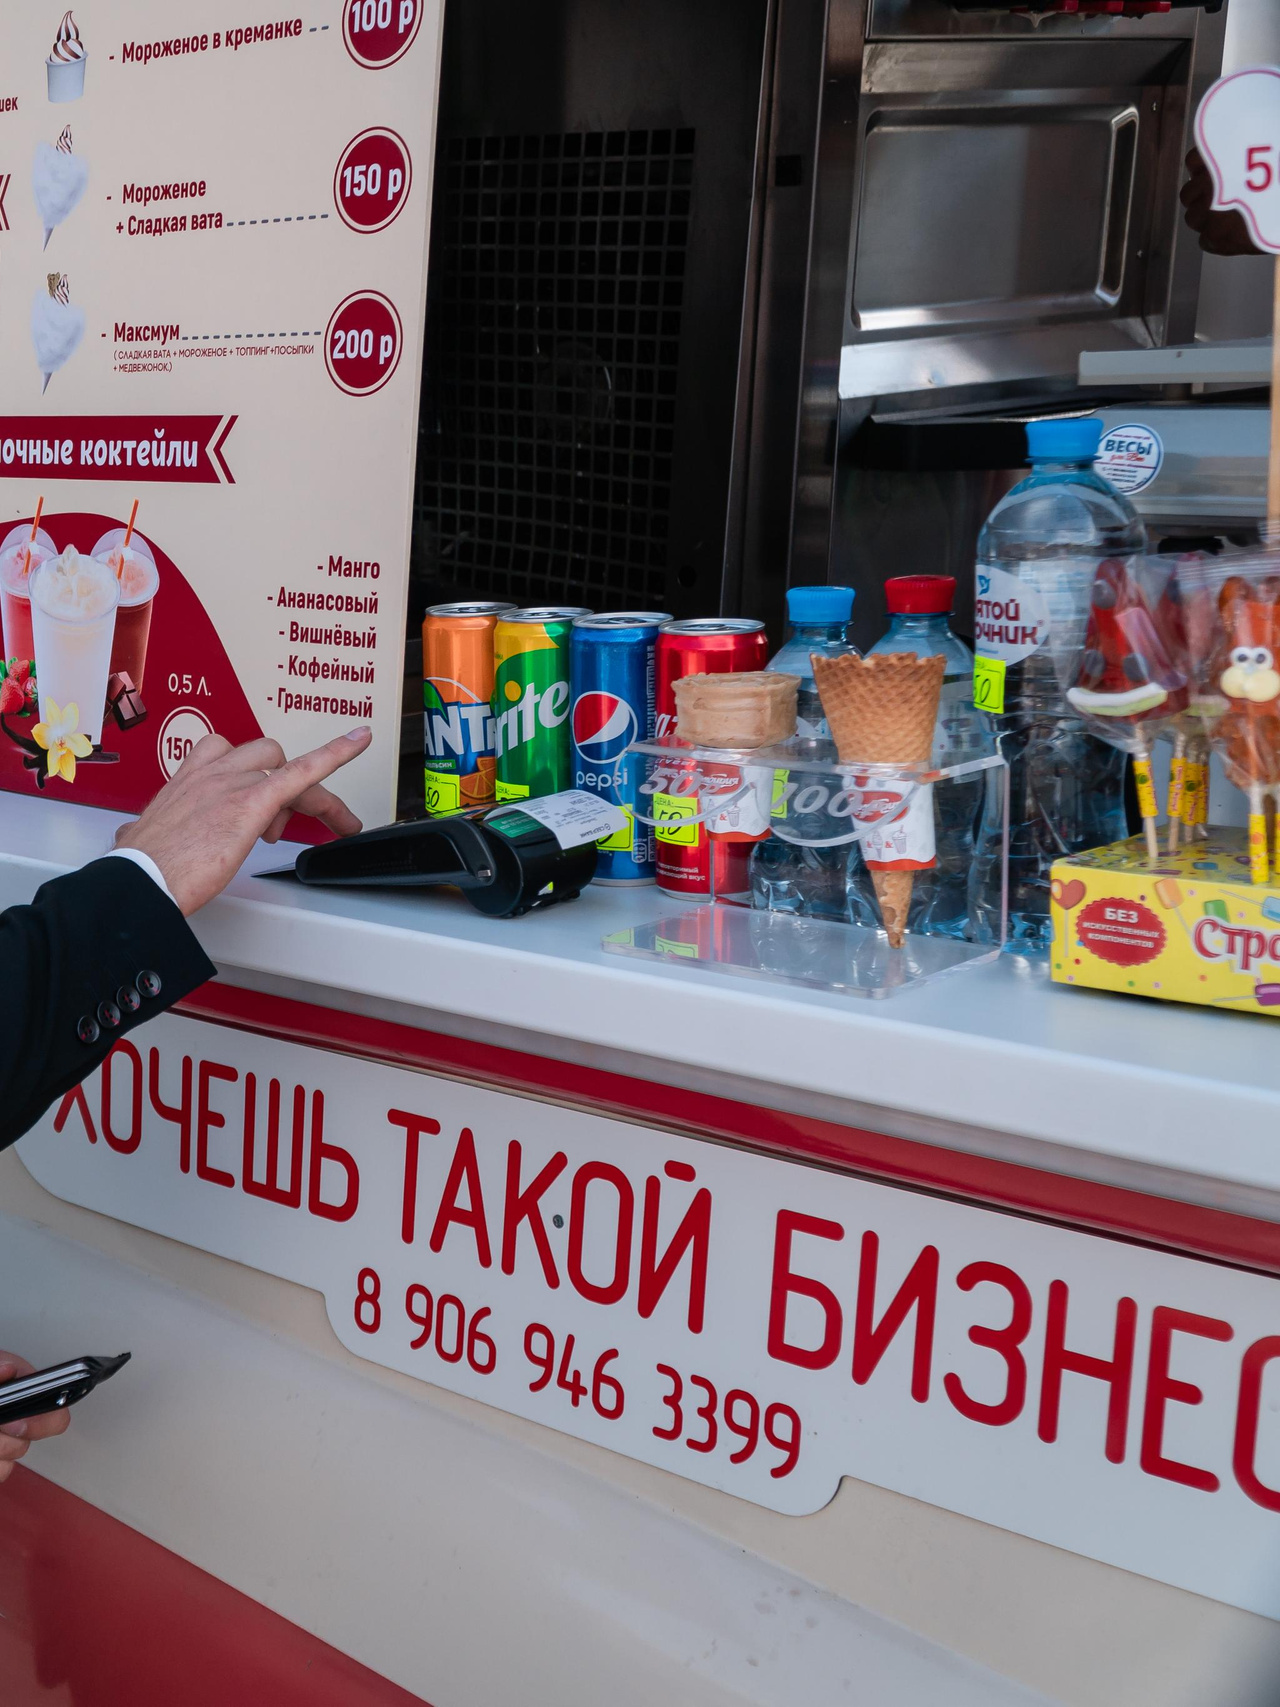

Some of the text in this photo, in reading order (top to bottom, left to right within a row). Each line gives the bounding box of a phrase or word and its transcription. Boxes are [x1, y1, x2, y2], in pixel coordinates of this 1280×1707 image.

[121, 18, 303, 65] Мороженое в креманке
[343, 163, 382, 196] 150
[1245, 145, 1280, 192] 5
[122, 179, 207, 204] Мороженое
[127, 212, 187, 238] Сладкая
[191, 209, 223, 232] вата
[114, 322, 180, 345] Максмум
[332, 329, 372, 359] 200
[154, 350, 171, 359] ВАТА
[179, 348, 227, 358] МОРОЖЕНОЕ
[80, 429, 198, 468] коктейли
[1104, 440, 1153, 455] ВЕСЫ
[327, 555, 381, 580] Манго
[277, 587, 379, 614] Ананасовый
[289, 623, 377, 650] Вишнёвый
[288, 656, 375, 684] Кофейный
[168, 673, 194, 695] 0,5
[277, 689, 373, 719] Гранатовый
[576, 769, 628, 792] pepsi
[1104, 907, 1139, 923] БЕЗ
[1082, 921, 1160, 939] ИСКУССТВЕННЫХ
[1088, 933, 1154, 949] КОМПОНЕНТОВ
[386, 1108, 713, 1335] ТАКОЙ
[352, 1267, 803, 1480] 8 906 946 3399
